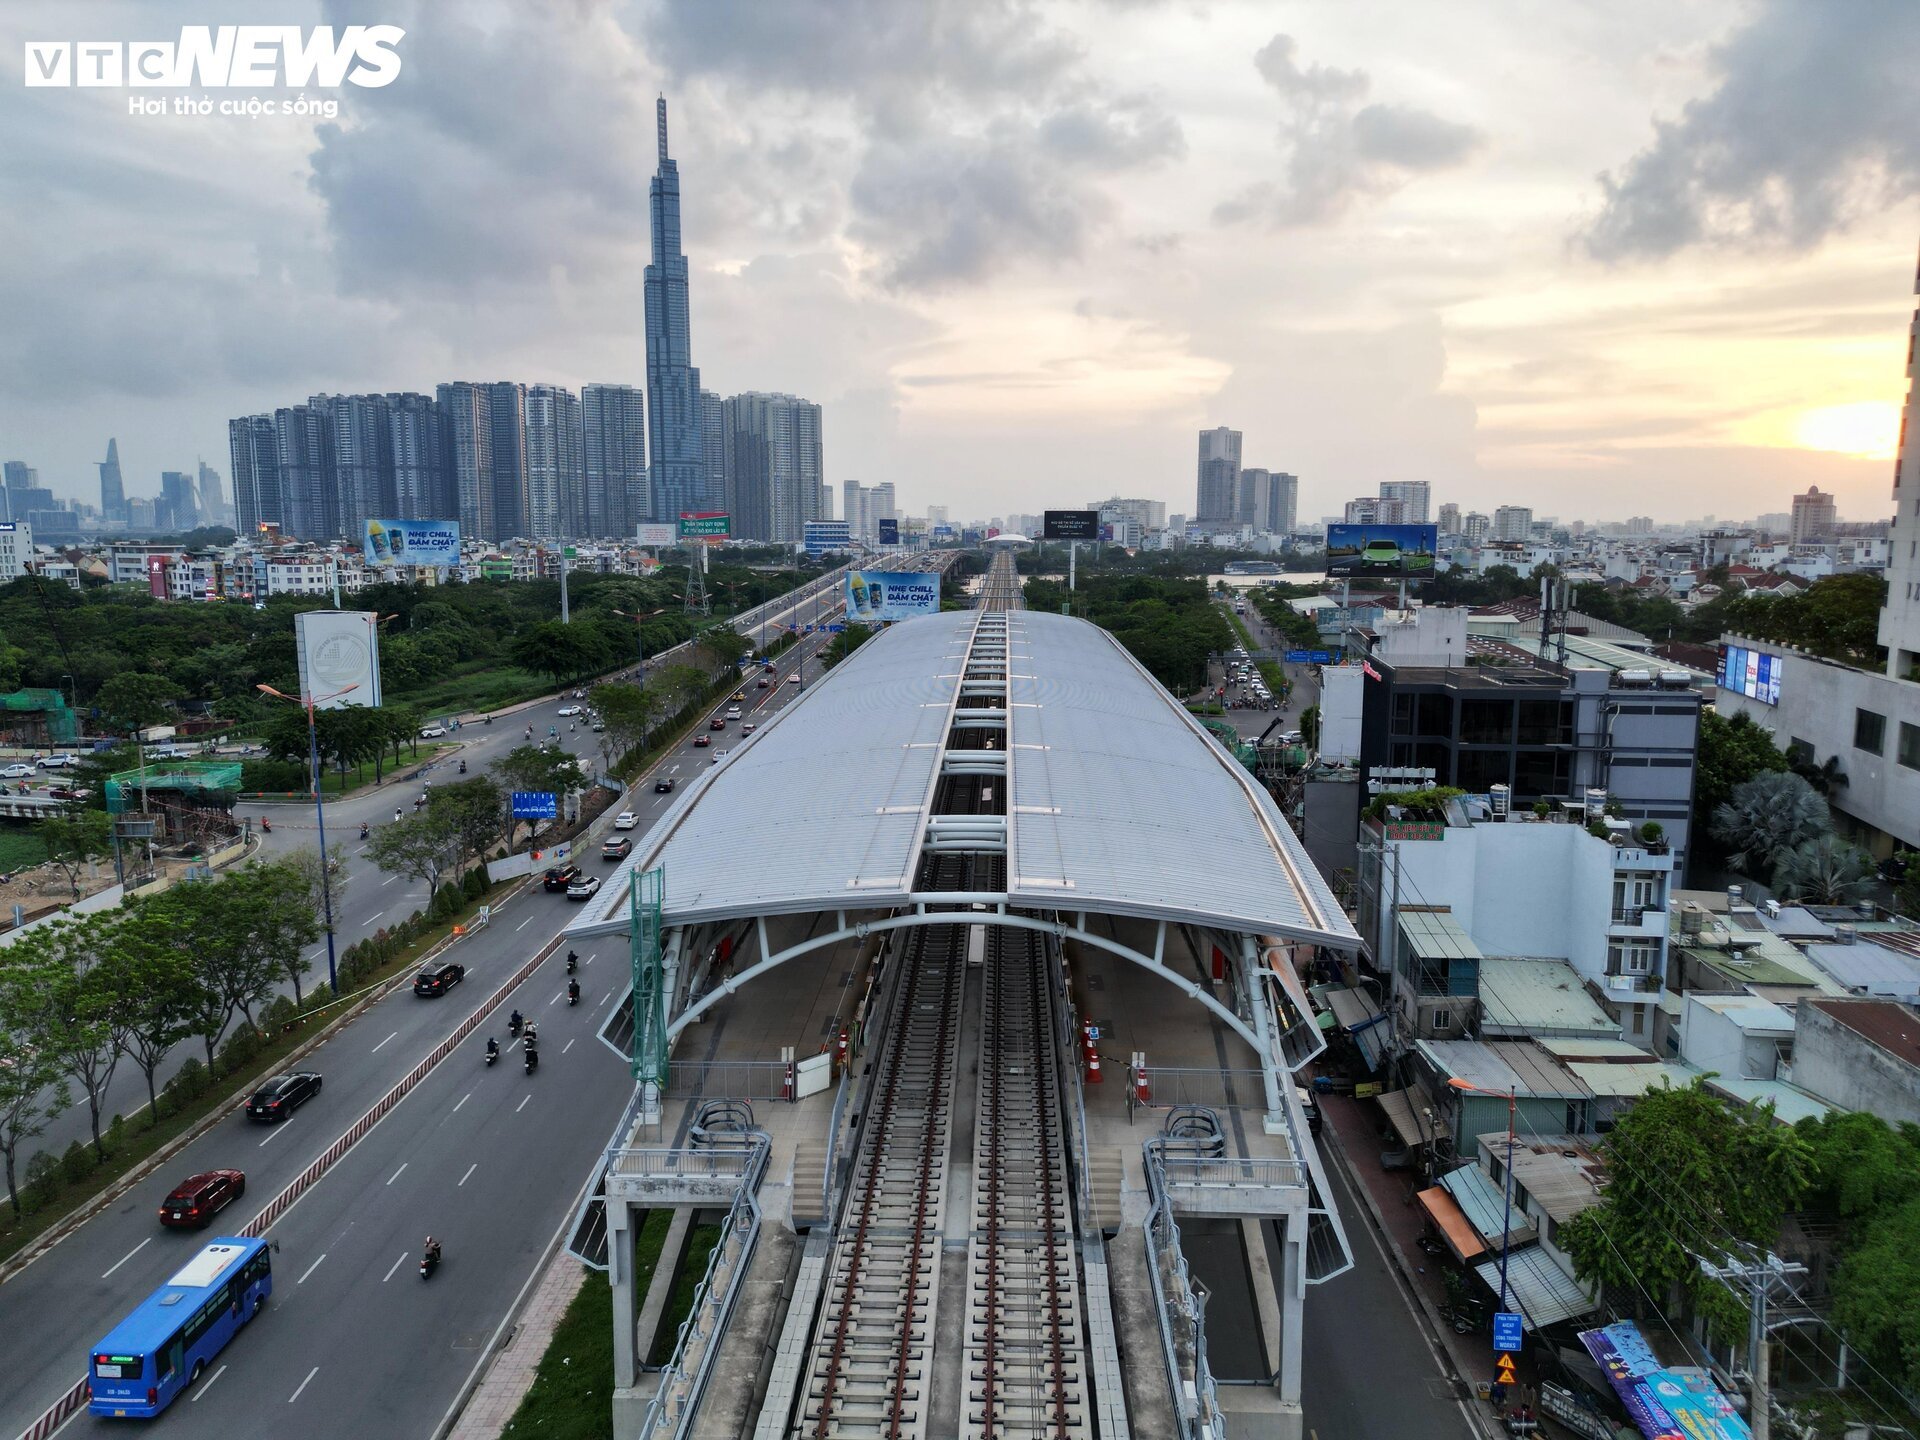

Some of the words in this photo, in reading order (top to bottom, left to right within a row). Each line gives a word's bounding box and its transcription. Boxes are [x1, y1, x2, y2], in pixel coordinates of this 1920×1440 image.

[431, 537, 456, 546] CHẤT
[888, 585, 907, 594] NHẸ
[908, 585, 934, 593] CHILL
[911, 592, 936, 601] CHẤT
